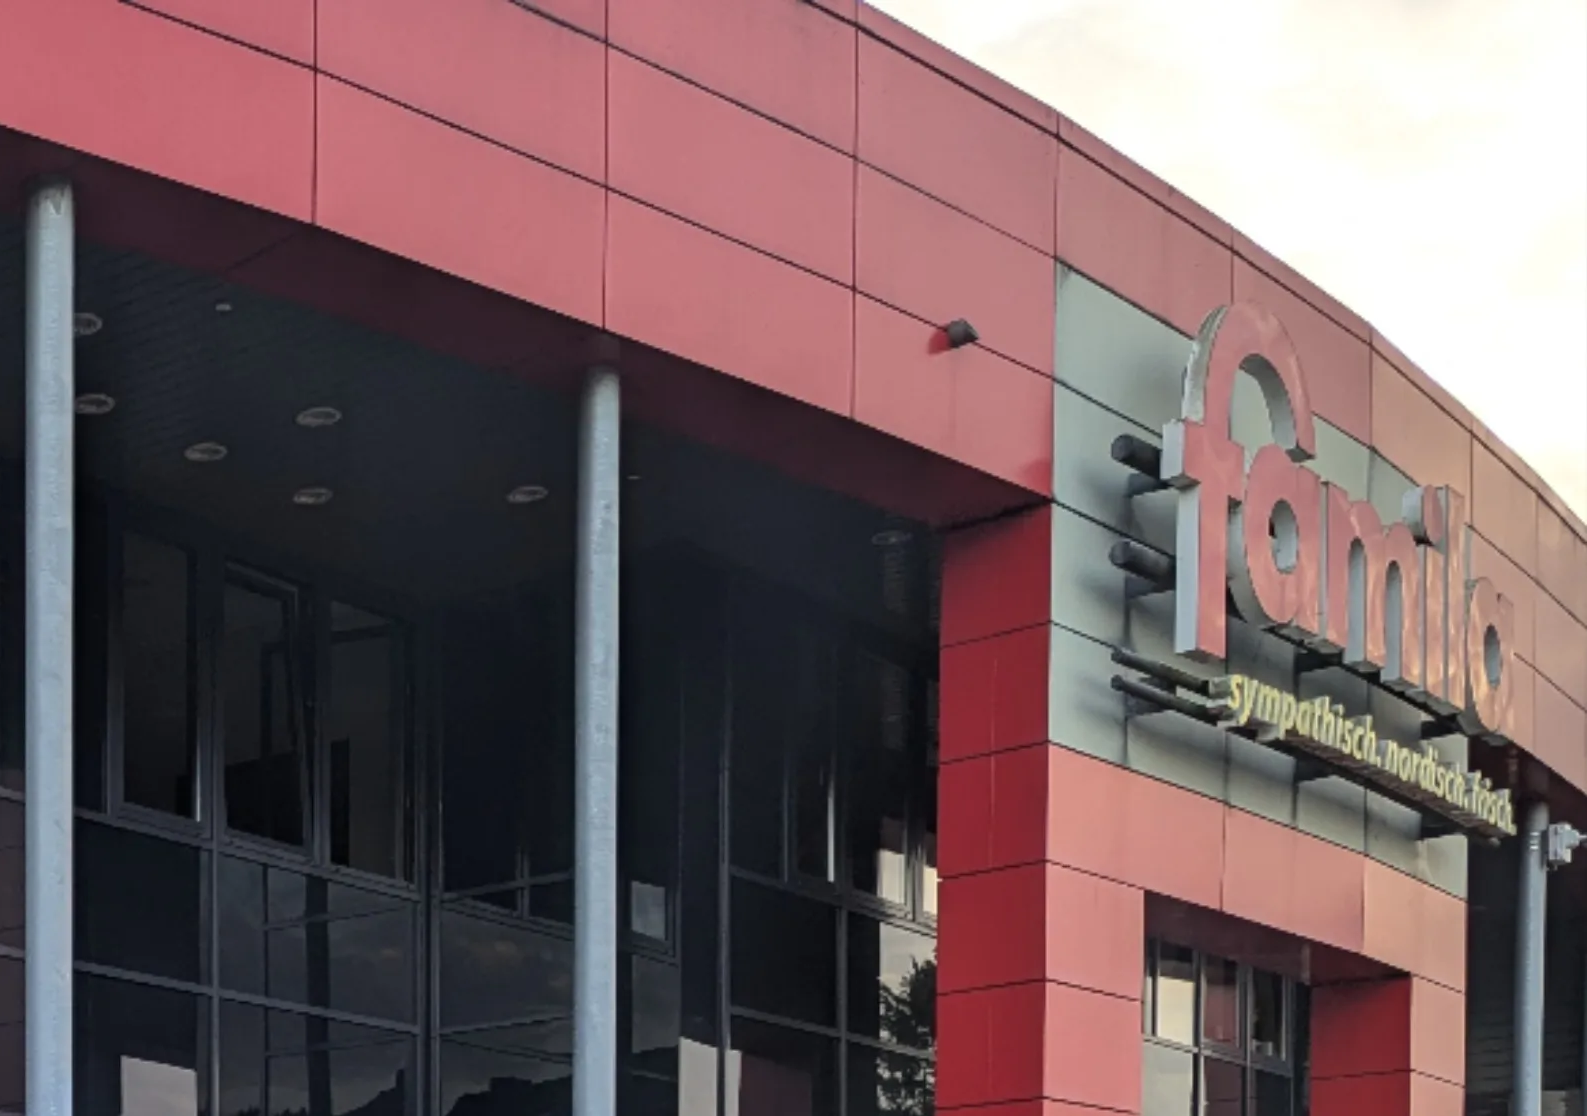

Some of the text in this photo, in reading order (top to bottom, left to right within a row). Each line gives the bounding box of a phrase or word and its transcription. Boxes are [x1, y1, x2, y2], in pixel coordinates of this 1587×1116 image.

[1162, 302, 1516, 735] famila
[1227, 673, 1382, 765] sympathisch.
[1385, 738, 1469, 808] nordisch.
